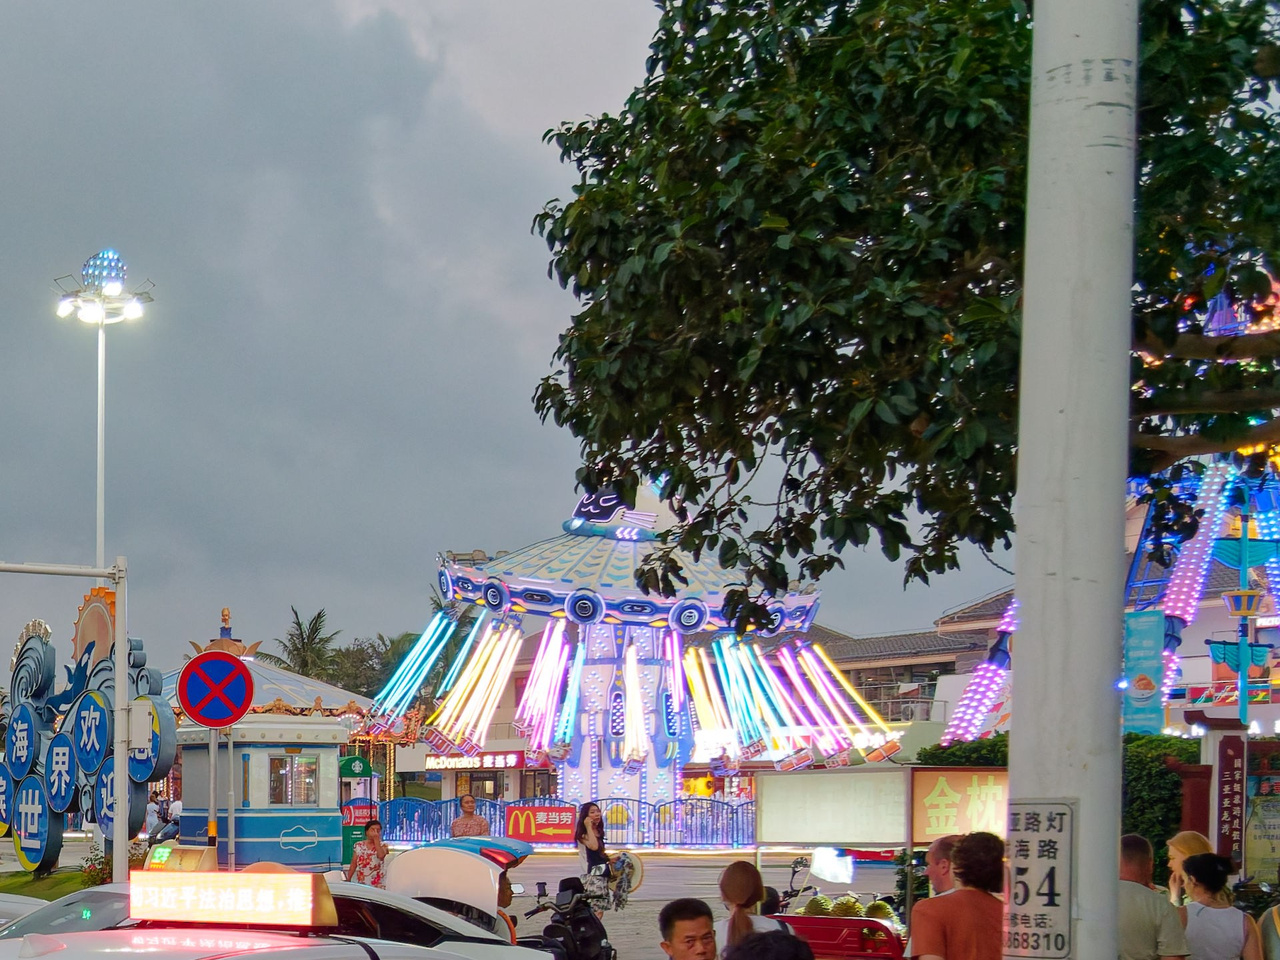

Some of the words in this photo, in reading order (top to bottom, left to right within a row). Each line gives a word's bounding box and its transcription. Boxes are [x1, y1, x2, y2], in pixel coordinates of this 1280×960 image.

[11, 720, 29, 764] 海
[80, 704, 101, 752] 欢
[49, 746, 71, 797] 界
[483, 754, 517, 768] 麦当劳
[18, 789, 43, 849] 世
[536, 811, 572, 824] 麦当劳
[923, 775, 1003, 834] 金枕
